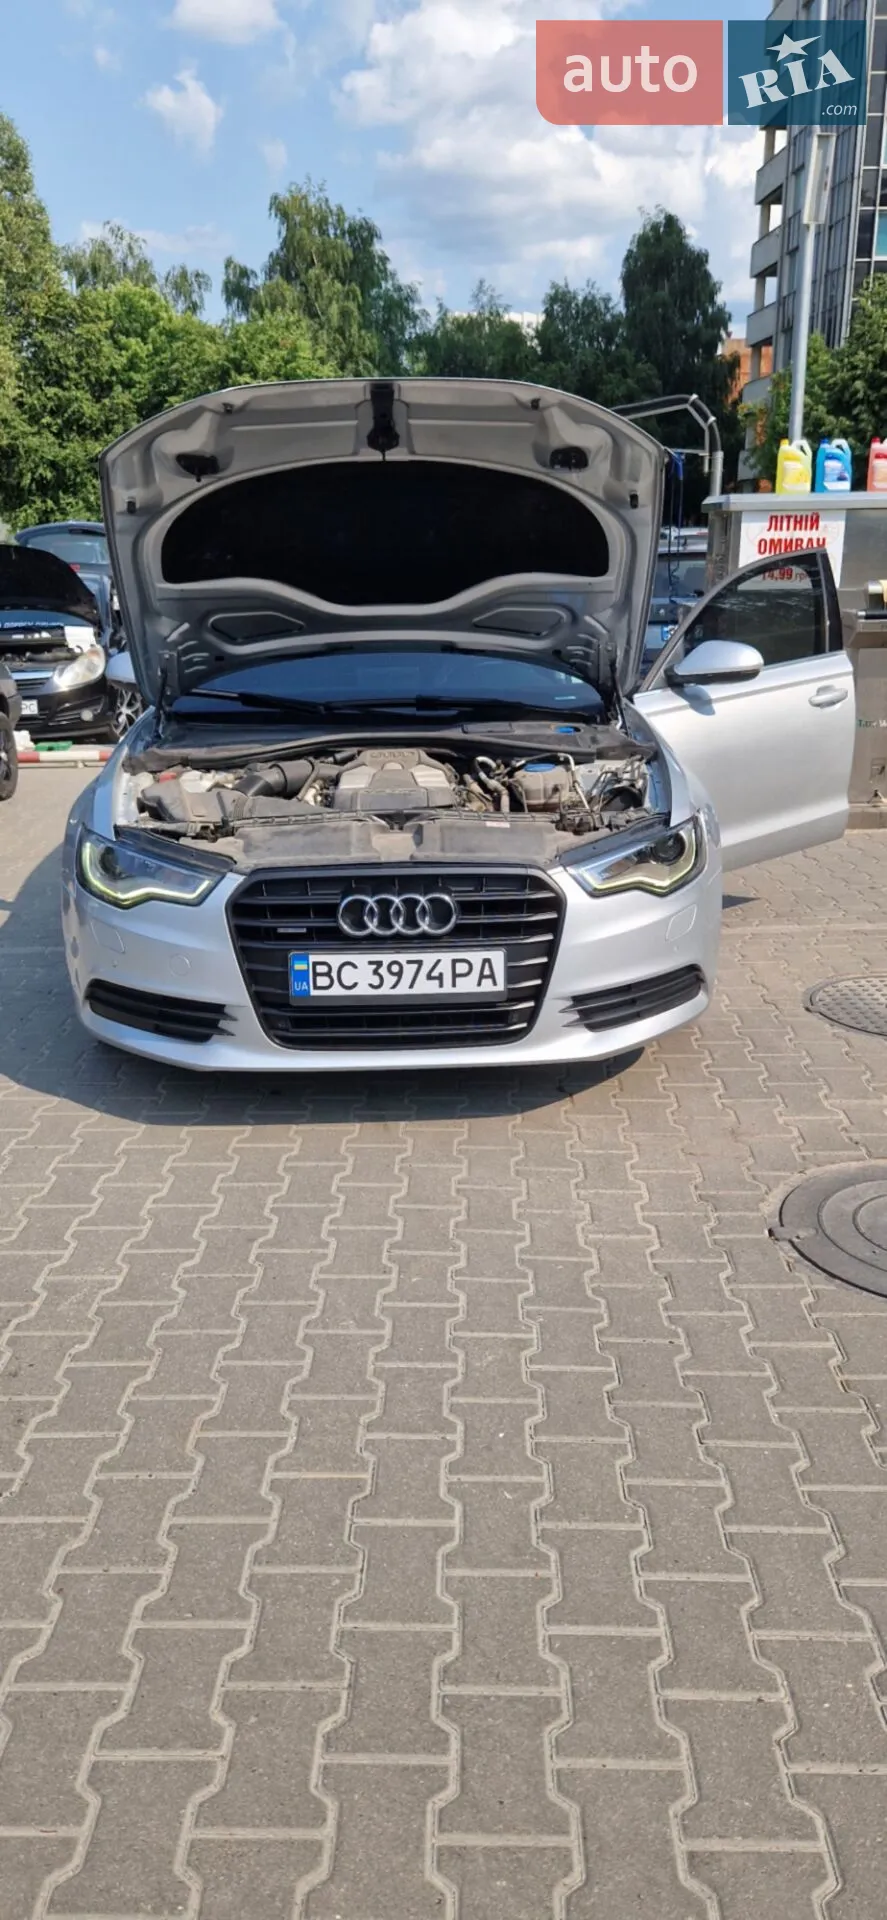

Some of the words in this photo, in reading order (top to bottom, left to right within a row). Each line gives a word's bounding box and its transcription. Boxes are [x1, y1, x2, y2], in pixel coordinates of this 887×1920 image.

[766, 512, 820, 532] ЛІТНІЙ
[311, 960, 359, 991] BC
[367, 958, 444, 990] 3974
[451, 957, 498, 988] PA
[294, 981, 309, 991] UA
